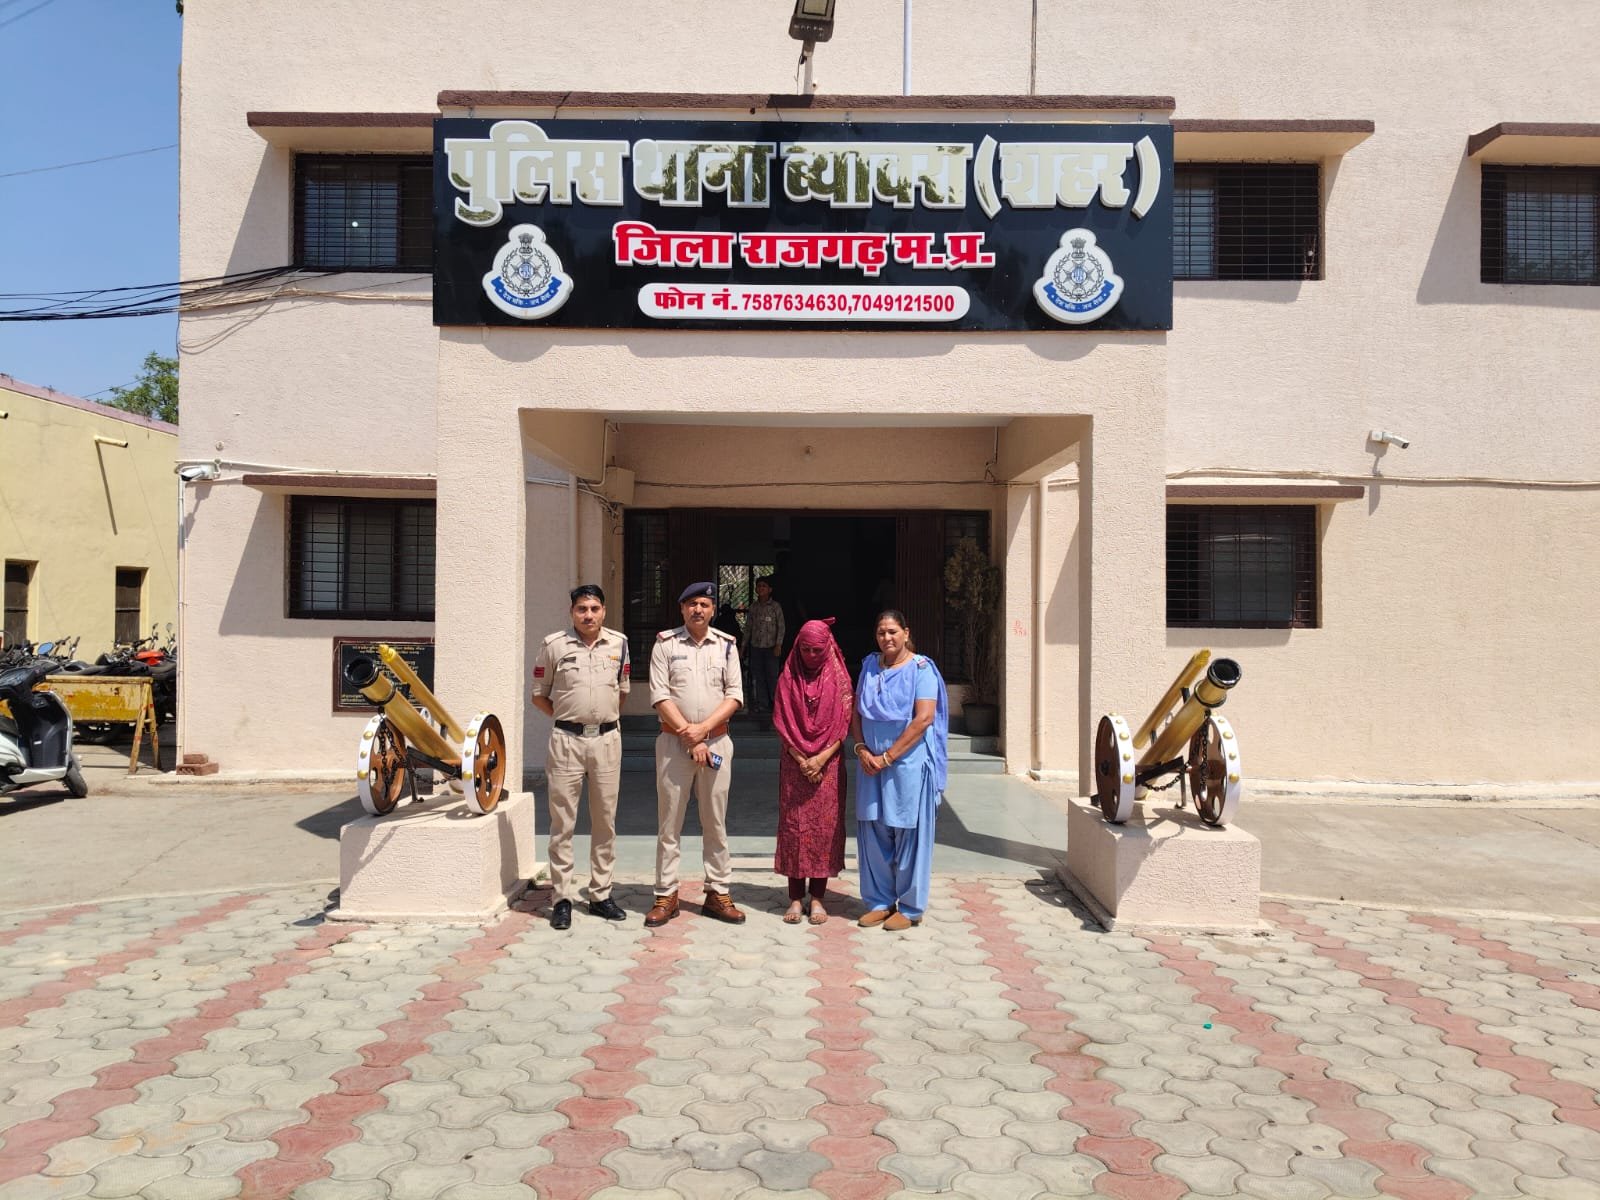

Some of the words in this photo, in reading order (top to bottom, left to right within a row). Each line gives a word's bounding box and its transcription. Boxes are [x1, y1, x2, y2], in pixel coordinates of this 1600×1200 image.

[444, 120, 630, 226] पुलिस
[633, 139, 774, 208] थाना
[973, 134, 1161, 220] (शहर)
[613, 221, 736, 268] जिला
[739, 232, 889, 277] राजगढ़
[654, 287, 705, 310] फोन
